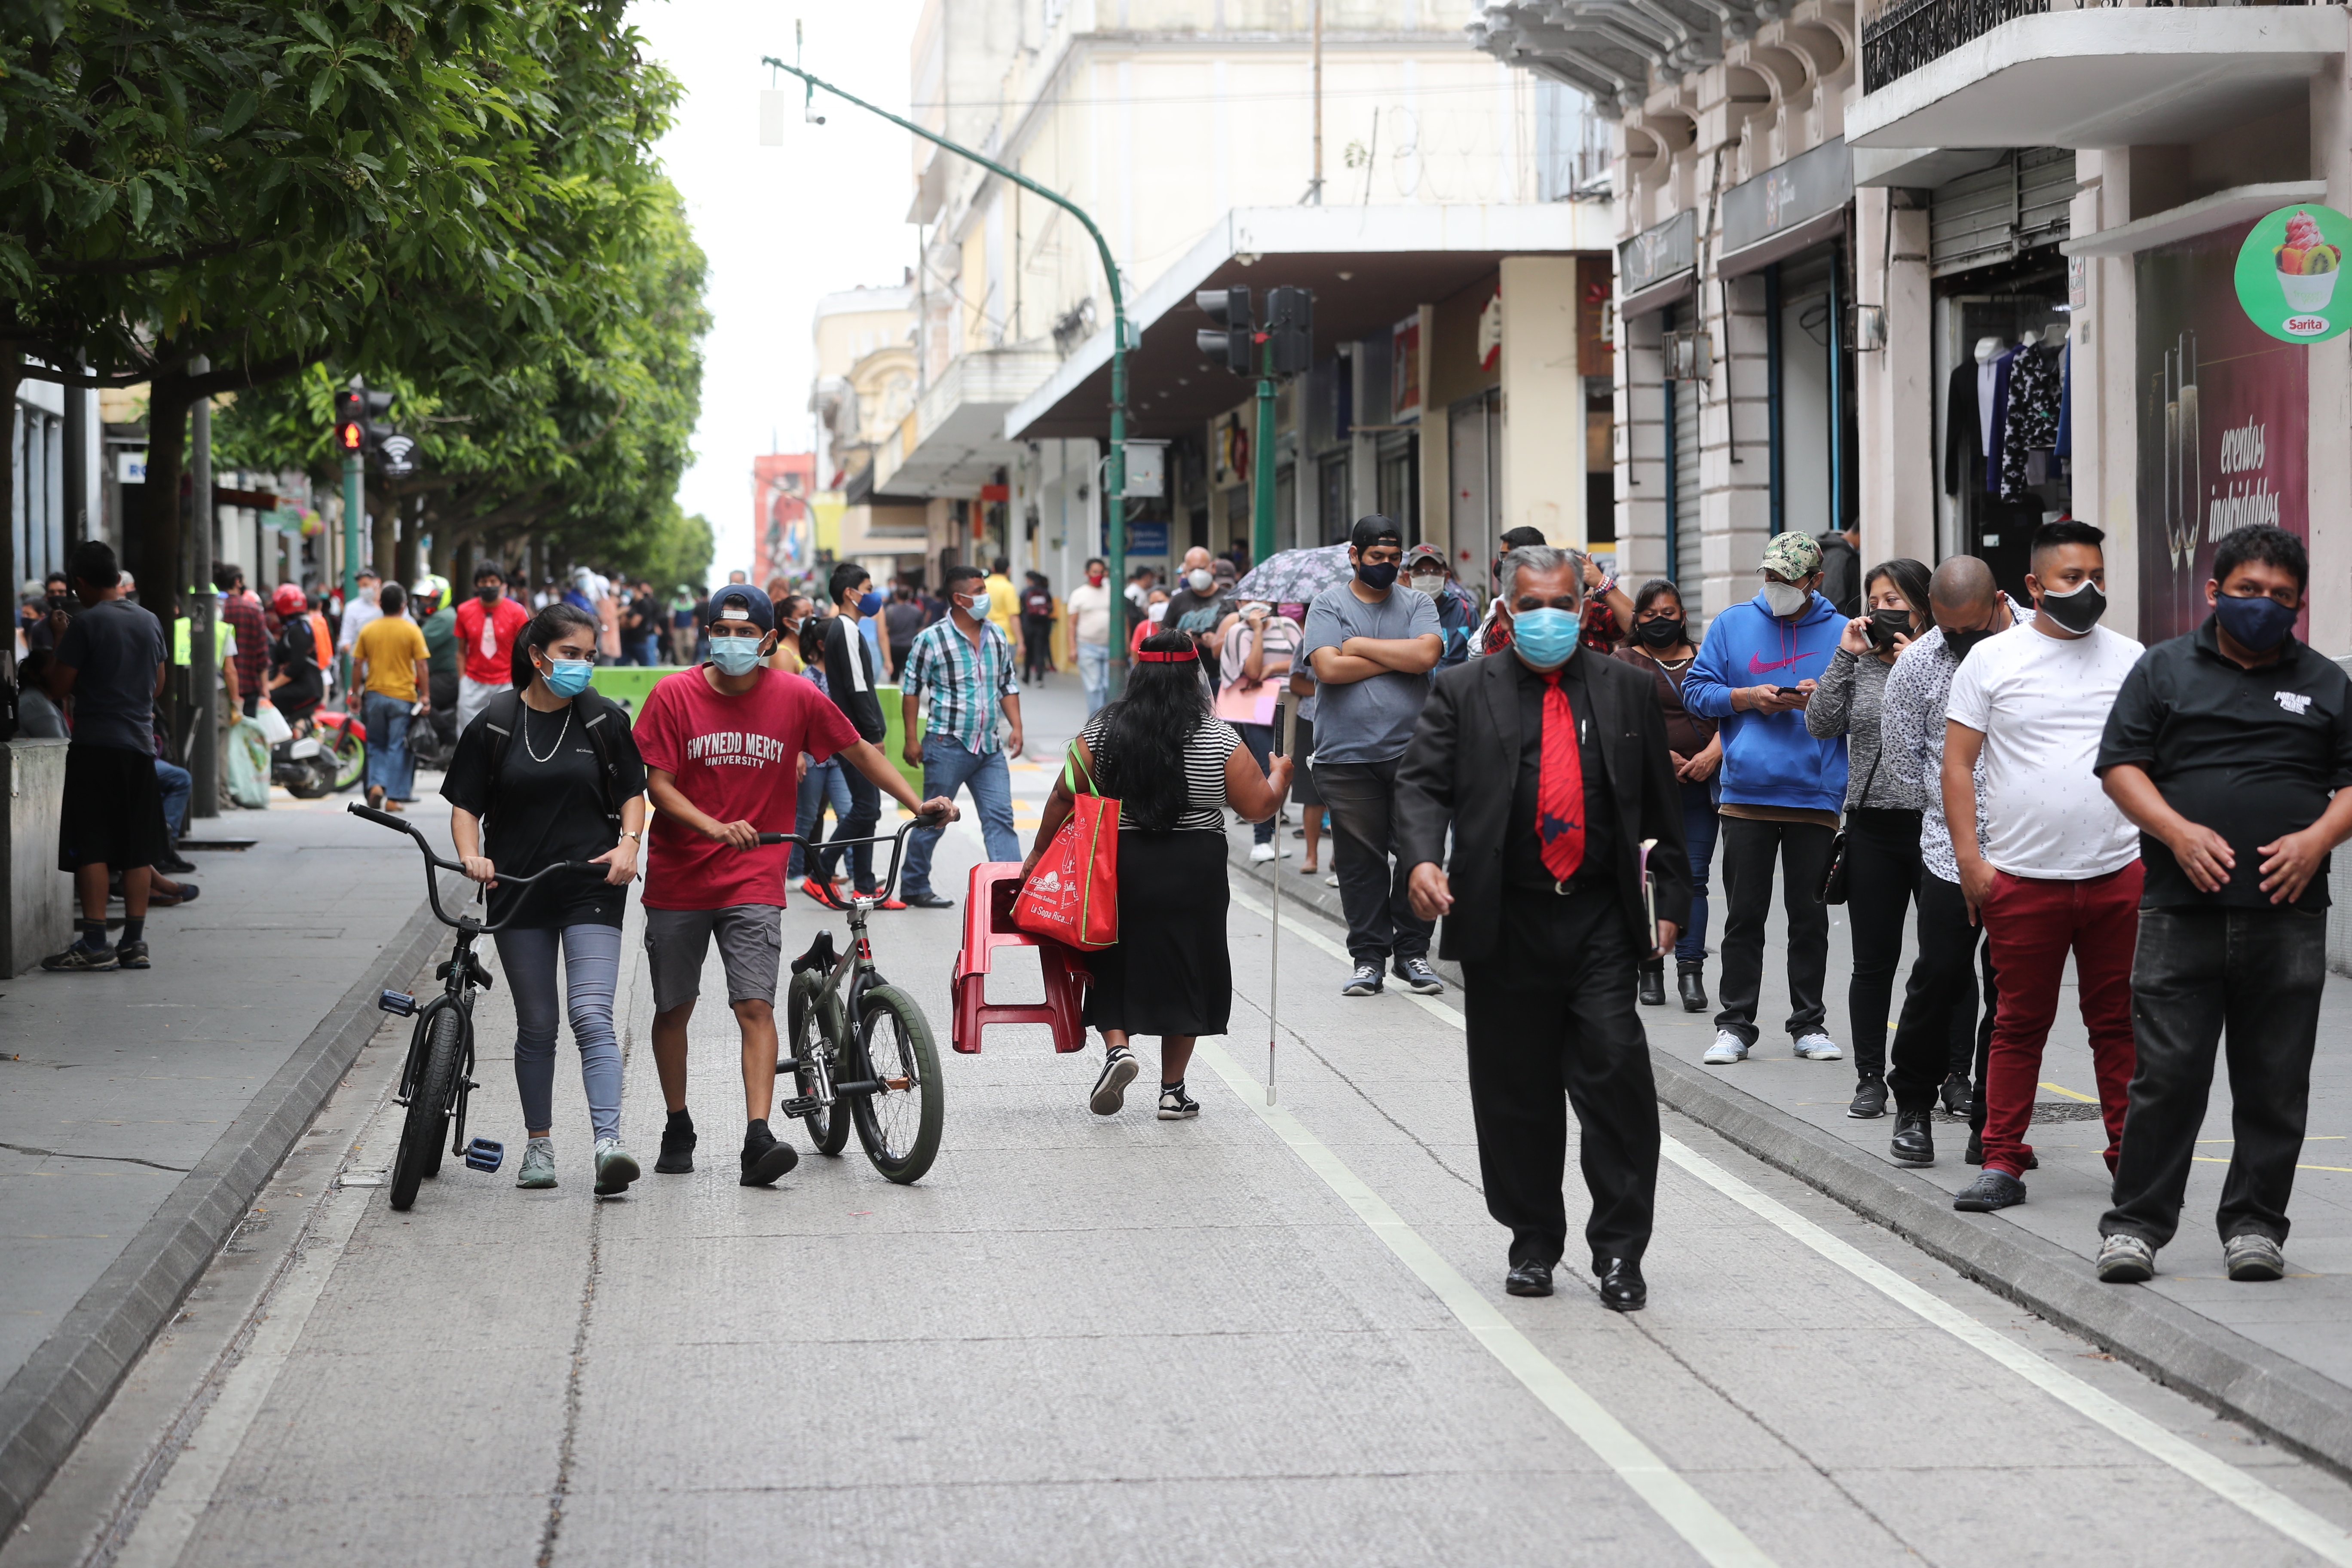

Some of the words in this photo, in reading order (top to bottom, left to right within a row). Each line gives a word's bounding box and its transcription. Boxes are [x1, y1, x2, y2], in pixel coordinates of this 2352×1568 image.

[2289, 319, 2322, 330] Sarita
[2221, 414, 2265, 474] eventos
[2208, 477, 2280, 543] inolvidables
[2274, 691, 2312, 705] PORTLAND
[2280, 699, 2305, 711] PILOTS
[688, 732, 742, 760] GWYNEDD
[745, 733, 784, 763] MERCY
[705, 755, 765, 769] UNIVERSITY
[1031, 903, 1038, 913] La
[1037, 906, 1052, 919] Sopa
